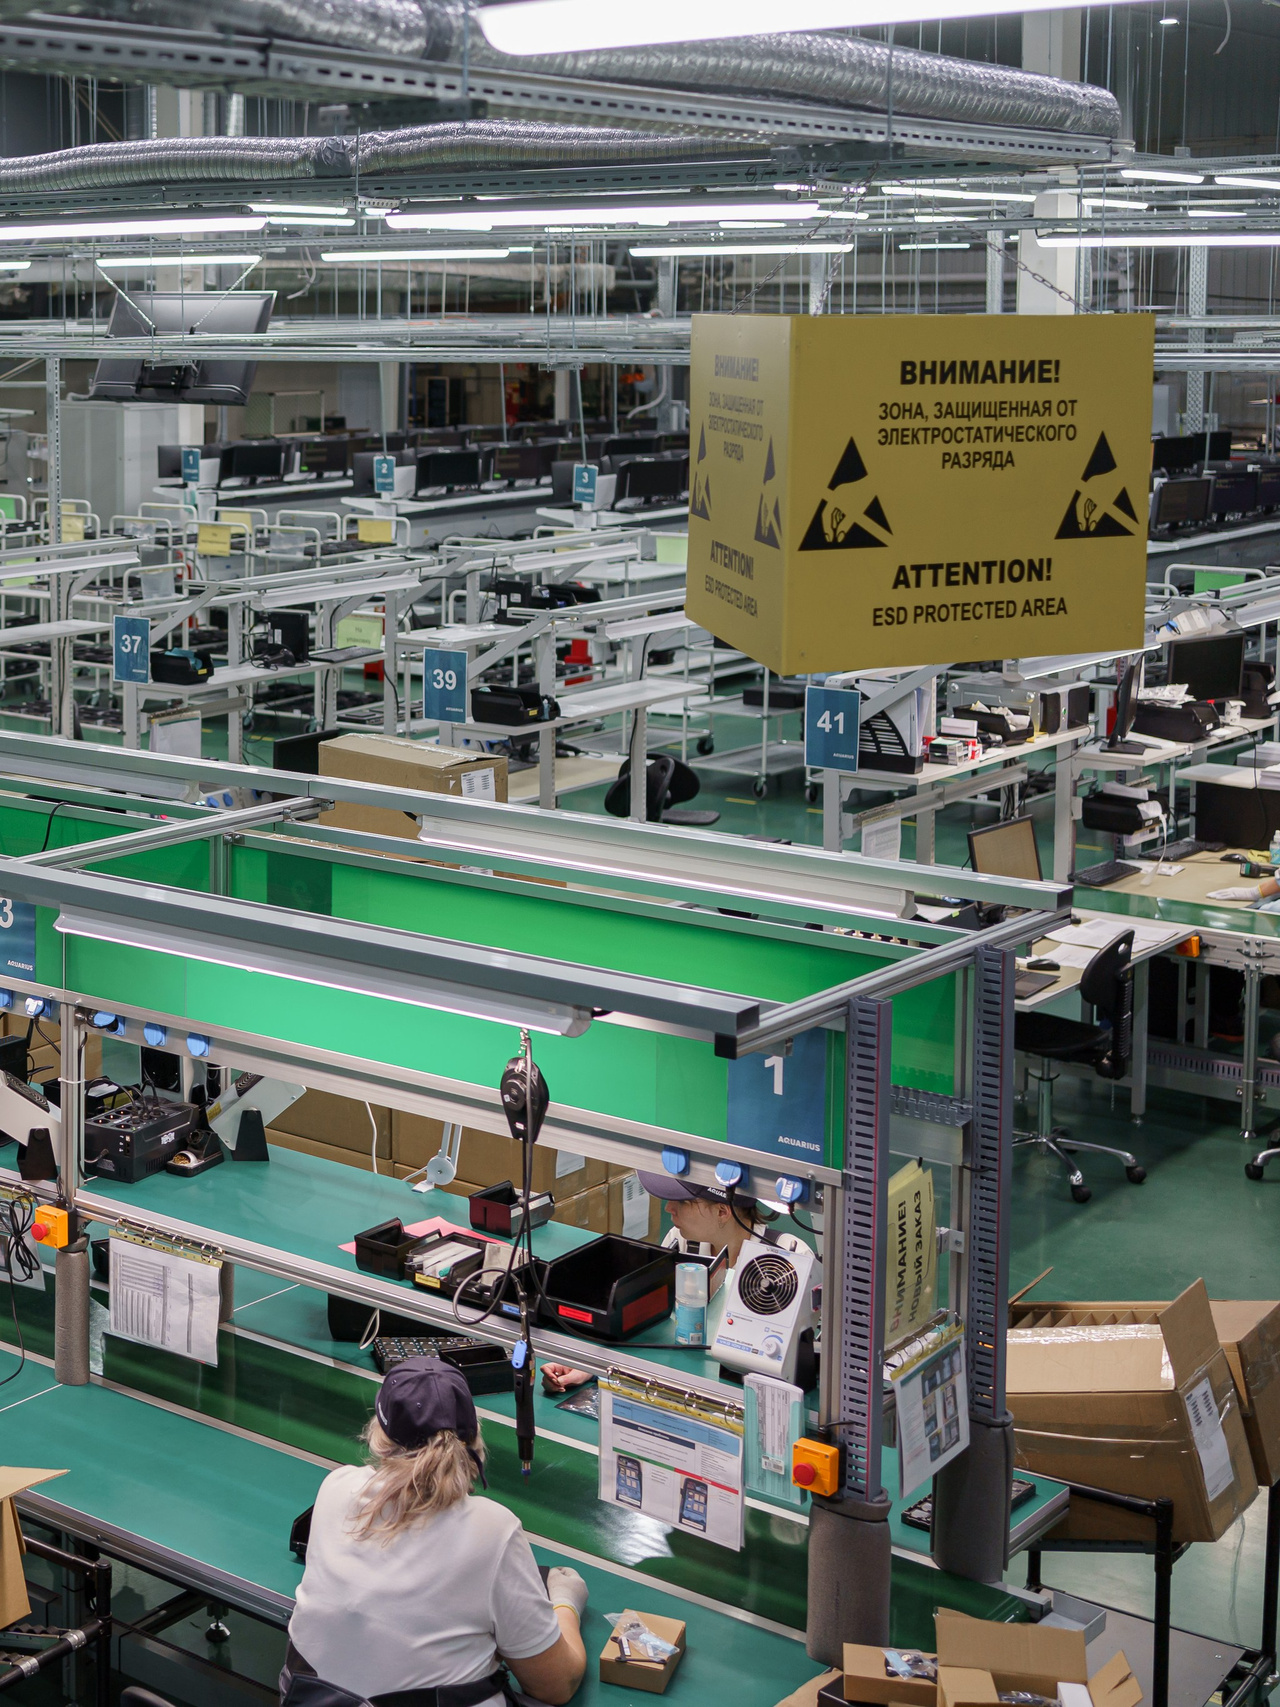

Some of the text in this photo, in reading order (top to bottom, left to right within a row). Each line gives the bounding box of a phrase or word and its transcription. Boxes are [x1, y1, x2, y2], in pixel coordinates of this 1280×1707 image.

[900, 359, 1060, 385] ВНИМАНИЕ!
[878, 399, 1078, 422] ЗОНА, ЗАЩИЩЕННАЯ ОТ
[877, 424, 1077, 446] ЭЛЕКТРОСТАТИЧЕСКОГО
[381, 462, 388, 474] 2
[941, 450, 1015, 471] РАЗРЯДА
[581, 471, 589, 484] 3
[710, 540, 754, 580] ATTENTION!
[891, 557, 1052, 590] ATTENTION!
[872, 597, 1068, 627] ESD PROTECTED AREA
[121, 634, 142, 654] 37
[432, 668, 457, 691] 39
[816, 710, 844, 735] 41
[7, 959, 34, 971] AQUARIUS
[764, 1055, 784, 1096] 1
[777, 1135, 821, 1152] AQUARIUS
[706, 1186, 729, 1199] AQUAR
[889, 1200, 907, 1333] ВНИМАНИЕ!
[908, 1190, 923, 1323] НОВЫЙ ЗАКАЗ
